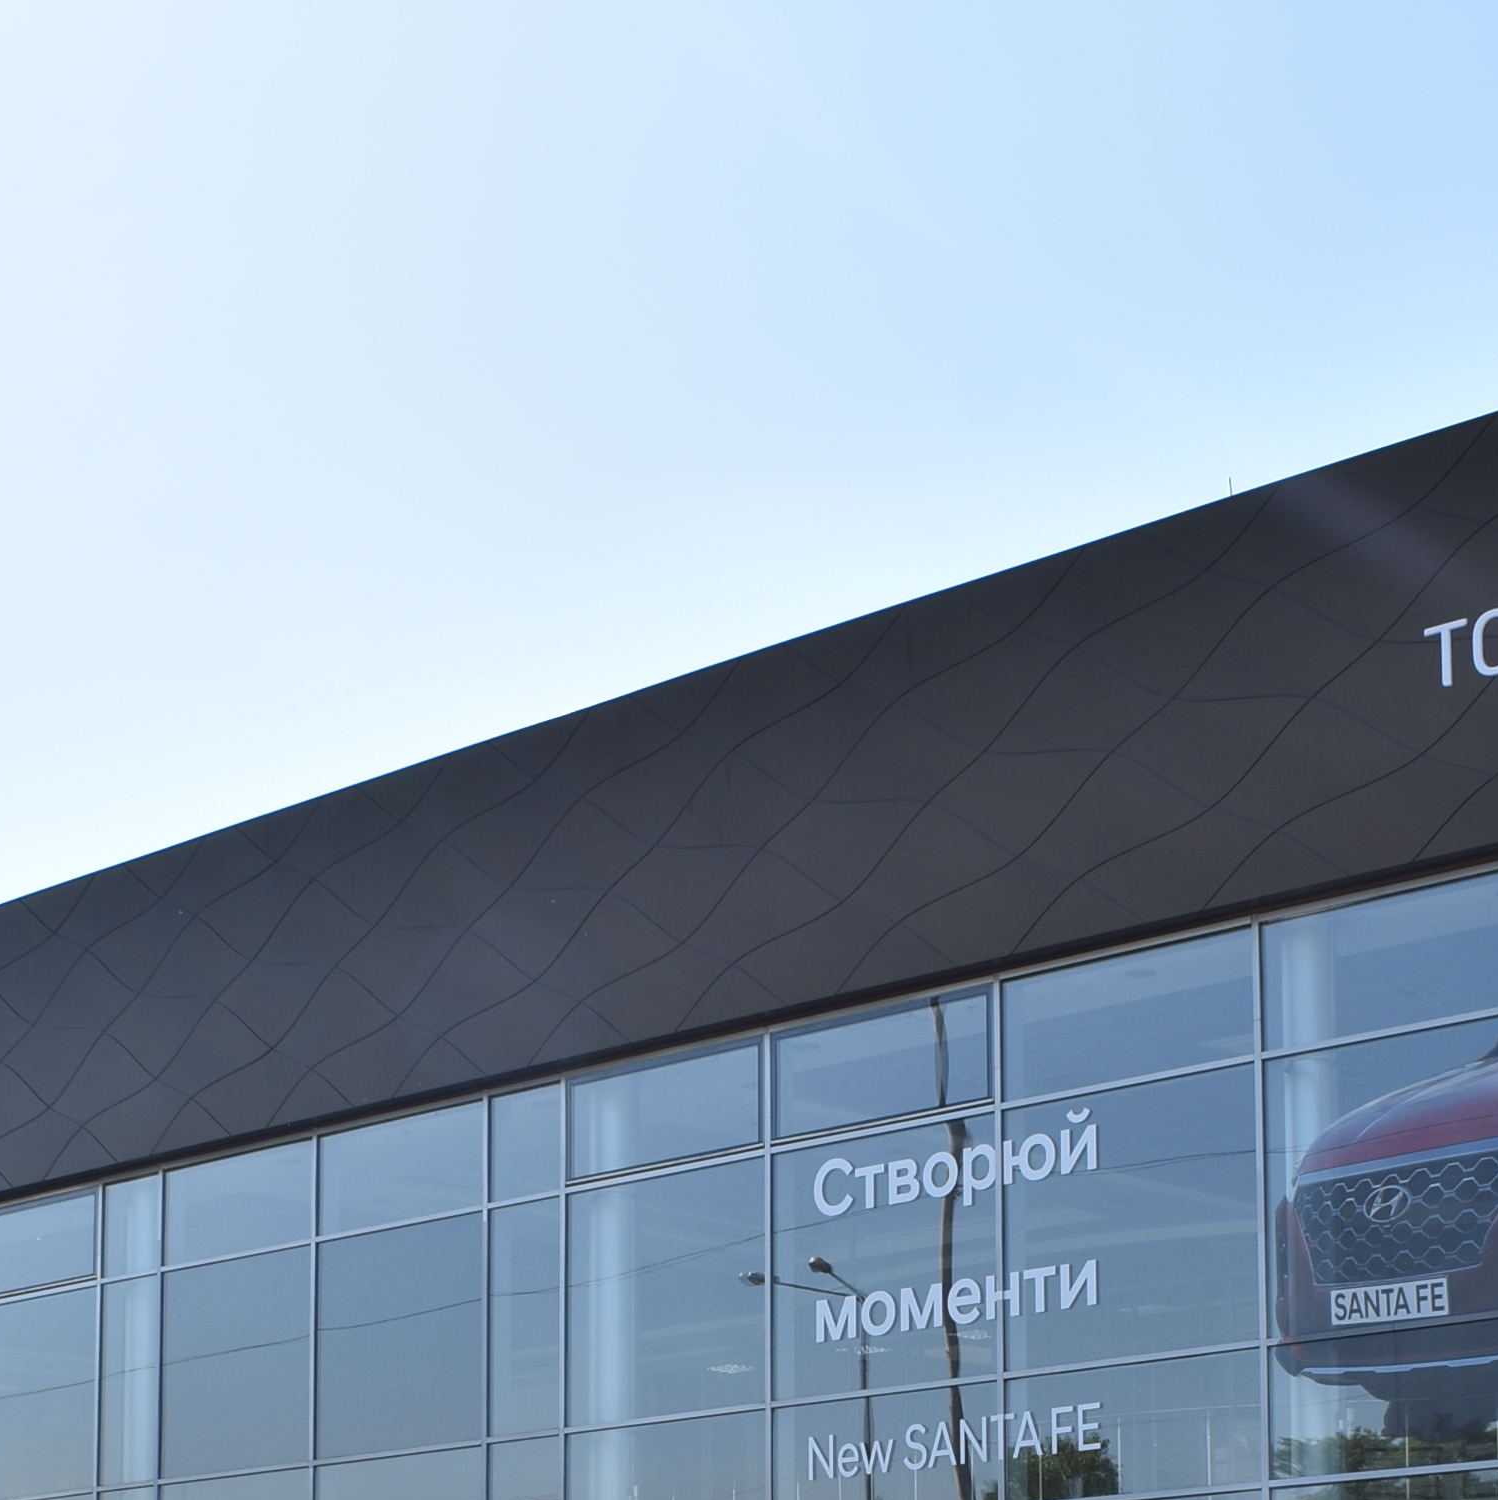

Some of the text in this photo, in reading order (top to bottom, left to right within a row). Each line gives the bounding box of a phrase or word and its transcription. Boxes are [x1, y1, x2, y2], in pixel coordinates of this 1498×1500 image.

[813, 1107, 1099, 1216] Створюй
[815, 1259, 1098, 1343] моменти
[1334, 1282, 1445, 1321] SANTA FE
[808, 1401, 1103, 1481] New SANTA FE
